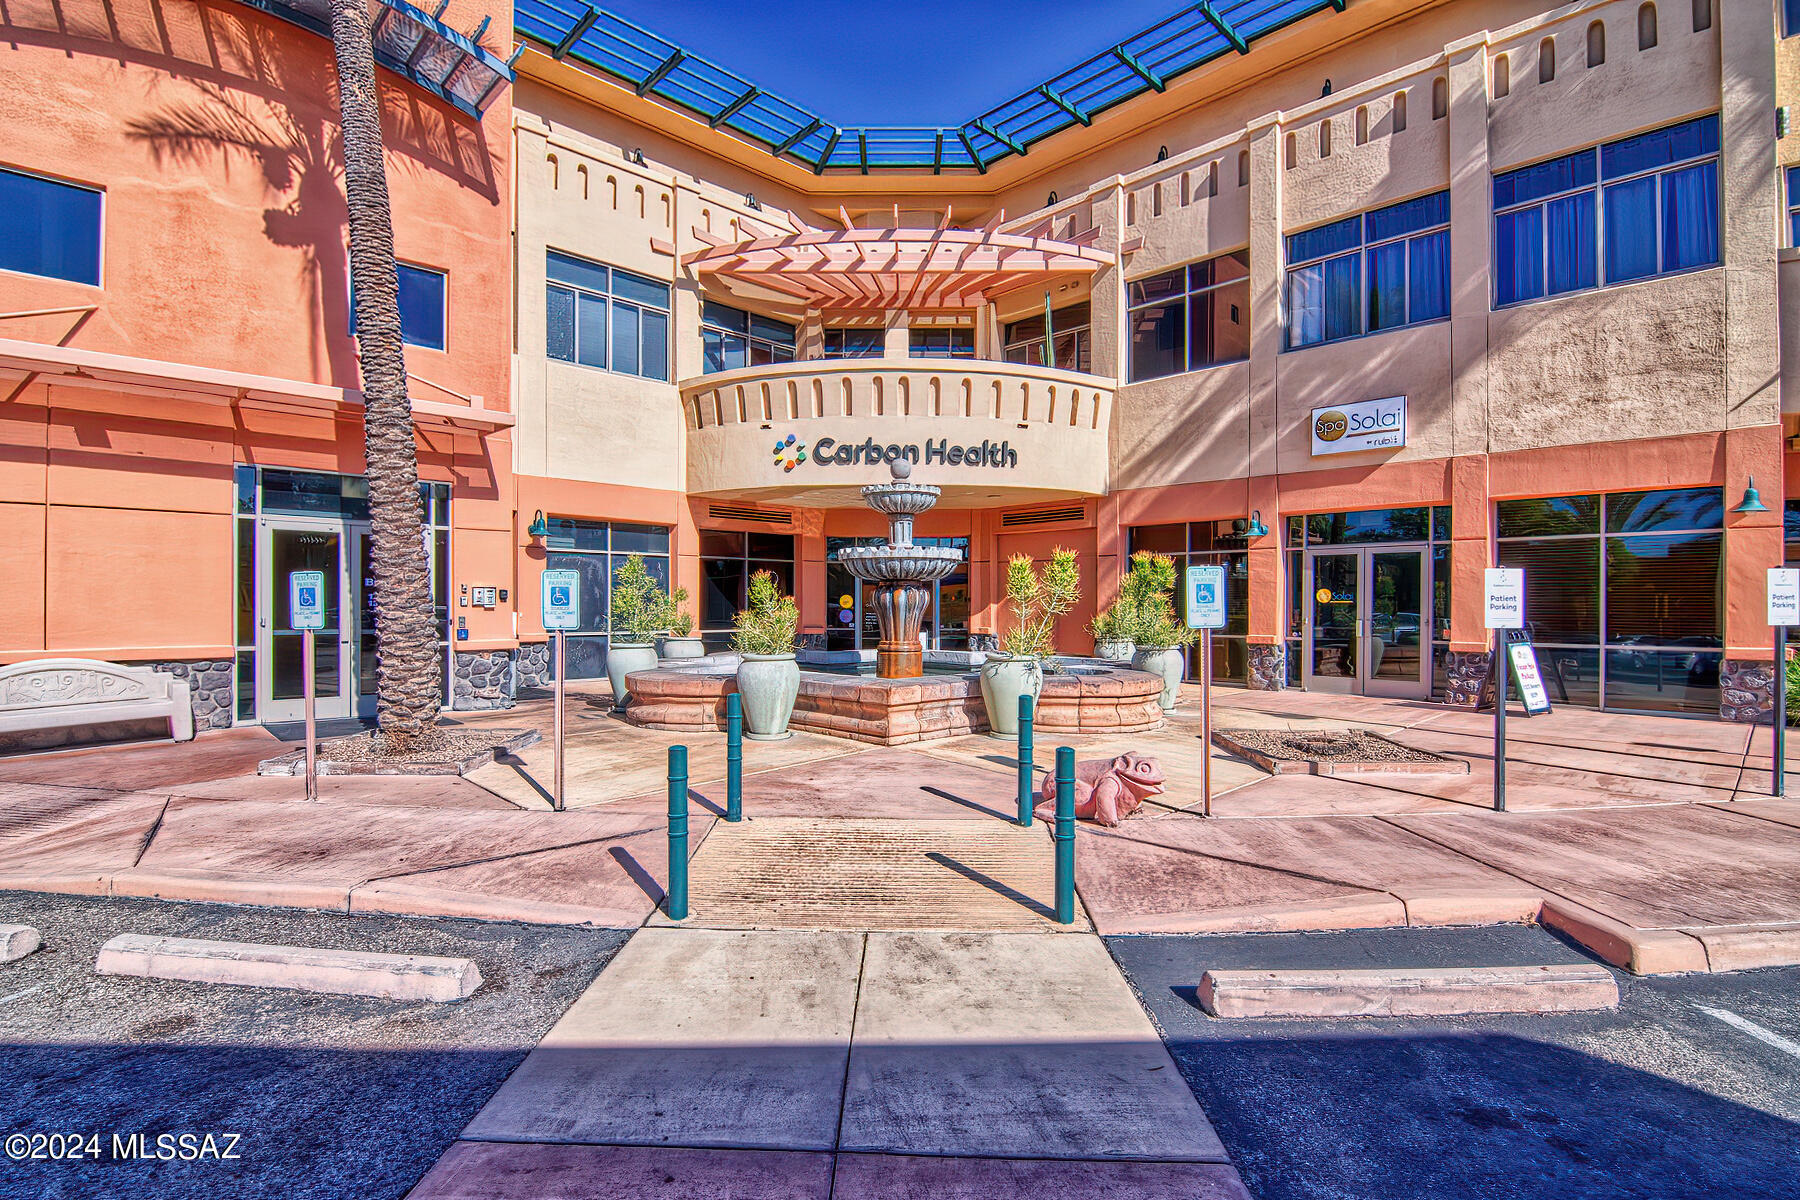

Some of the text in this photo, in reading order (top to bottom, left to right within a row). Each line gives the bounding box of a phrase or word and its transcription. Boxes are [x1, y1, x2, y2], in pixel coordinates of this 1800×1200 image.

[1351, 408, 1400, 430] Solai
[812, 437, 1017, 468] Carbon Health
[1489, 603, 1518, 612] Parking
[1771, 602, 1796, 610] Parking
